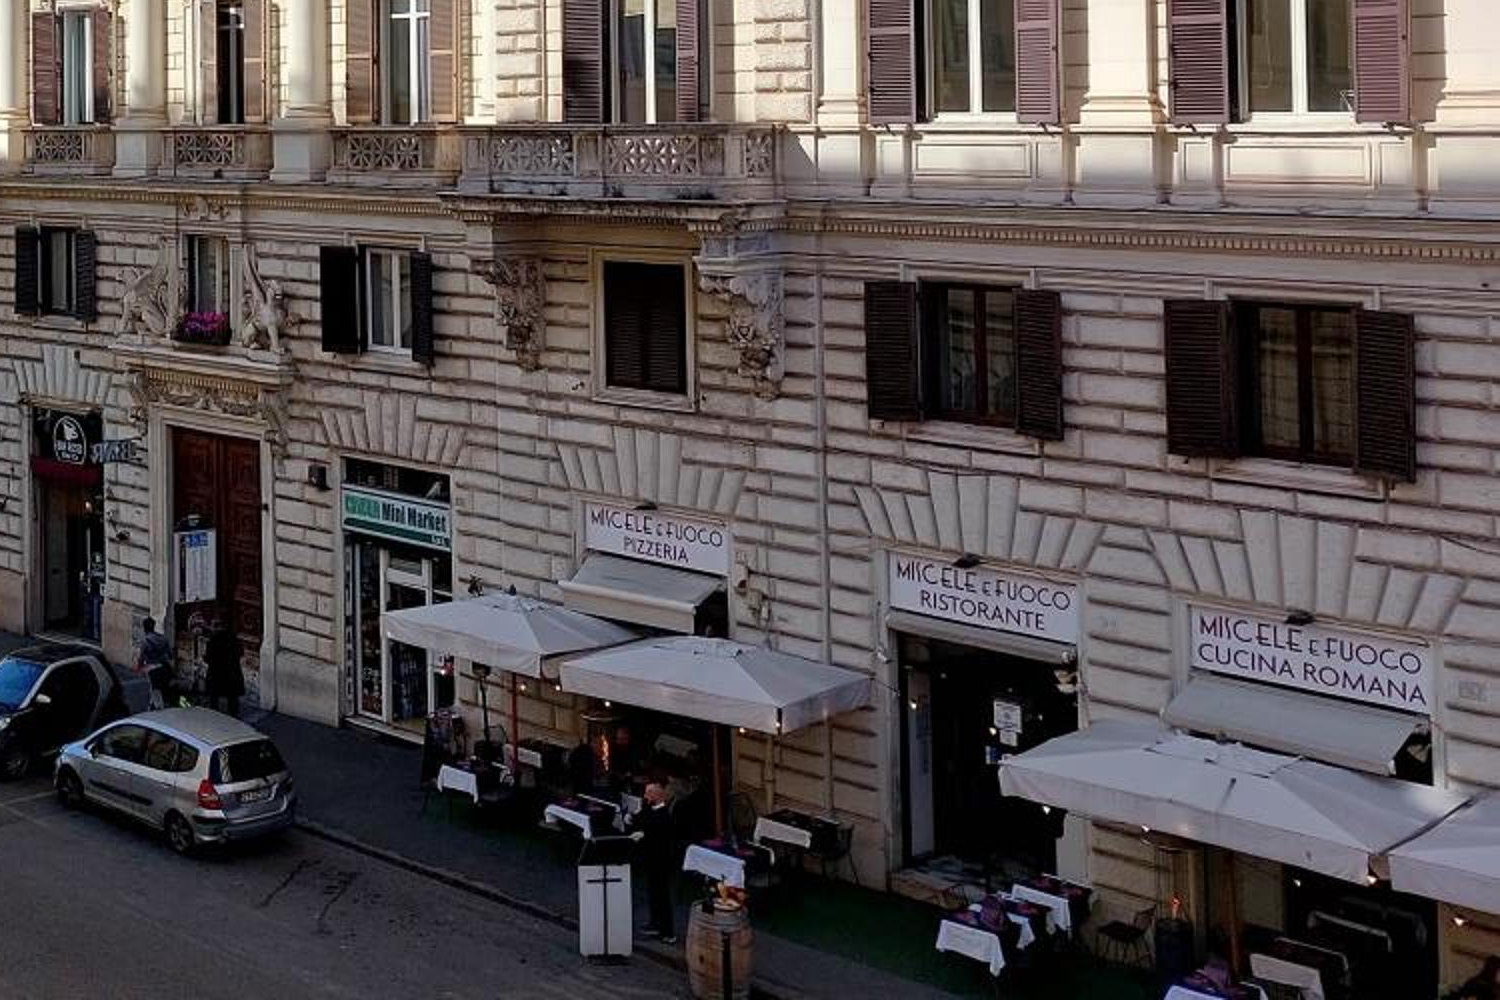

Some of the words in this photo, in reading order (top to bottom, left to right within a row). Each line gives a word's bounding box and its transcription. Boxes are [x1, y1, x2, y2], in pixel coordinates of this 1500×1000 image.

[381, 502, 406, 525] Mini
[407, 507, 446, 533] Market
[666, 520, 723, 548] FUOCO
[623, 535, 689, 563] PIZZERIA
[897, 560, 978, 594] MISCELE
[995, 579, 1070, 611] FUOCO
[920, 590, 1045, 631] RISTORANTE
[1199, 615, 1303, 653] MISCELE
[1325, 637, 1422, 674] FUOCO
[1198, 643, 1295, 679] CUCINA
[1303, 663, 1427, 705] ROMANA
